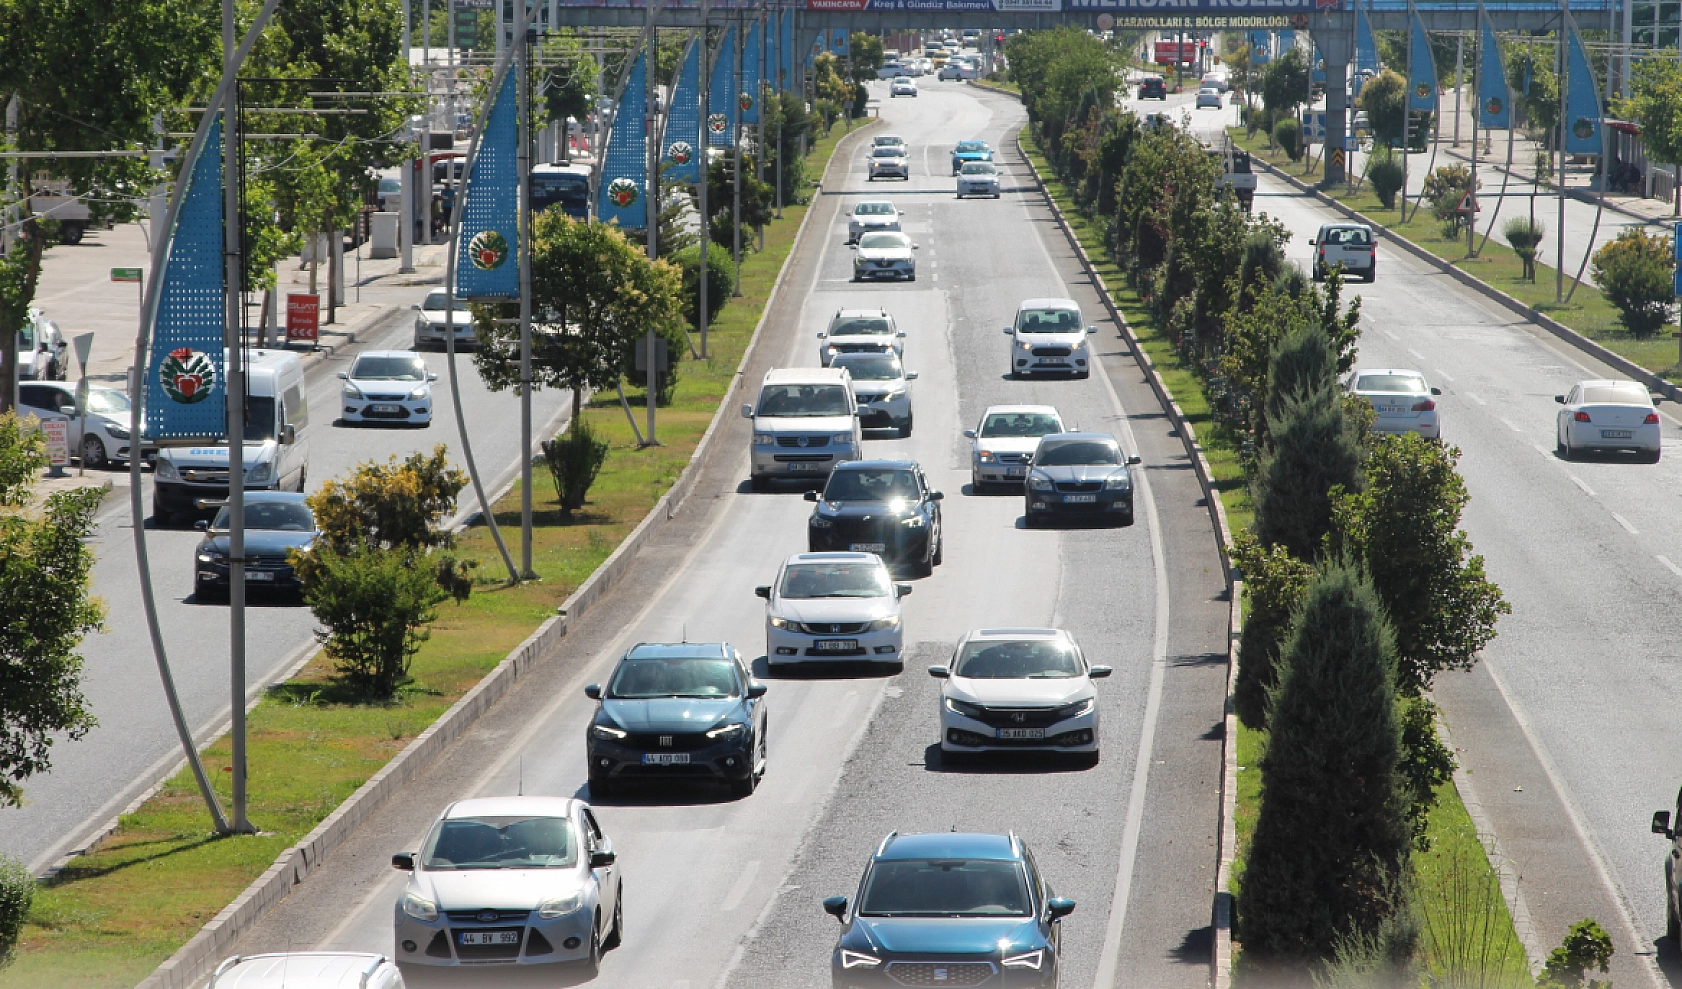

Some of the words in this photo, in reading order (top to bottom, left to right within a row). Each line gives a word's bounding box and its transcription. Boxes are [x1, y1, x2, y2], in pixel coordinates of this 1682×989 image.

[813, 0, 861, 8] YAKINCA'DA
[897, 0, 904, 8] &
[1116, 16, 1182, 27] KARAYOLLARI
[1184, 16, 1193, 27] 8.
[1195, 16, 1228, 27] BÖLGE
[1229, 15, 1289, 27] MÜDÜRLÜĞÜ
[464, 933, 475, 943] 44
